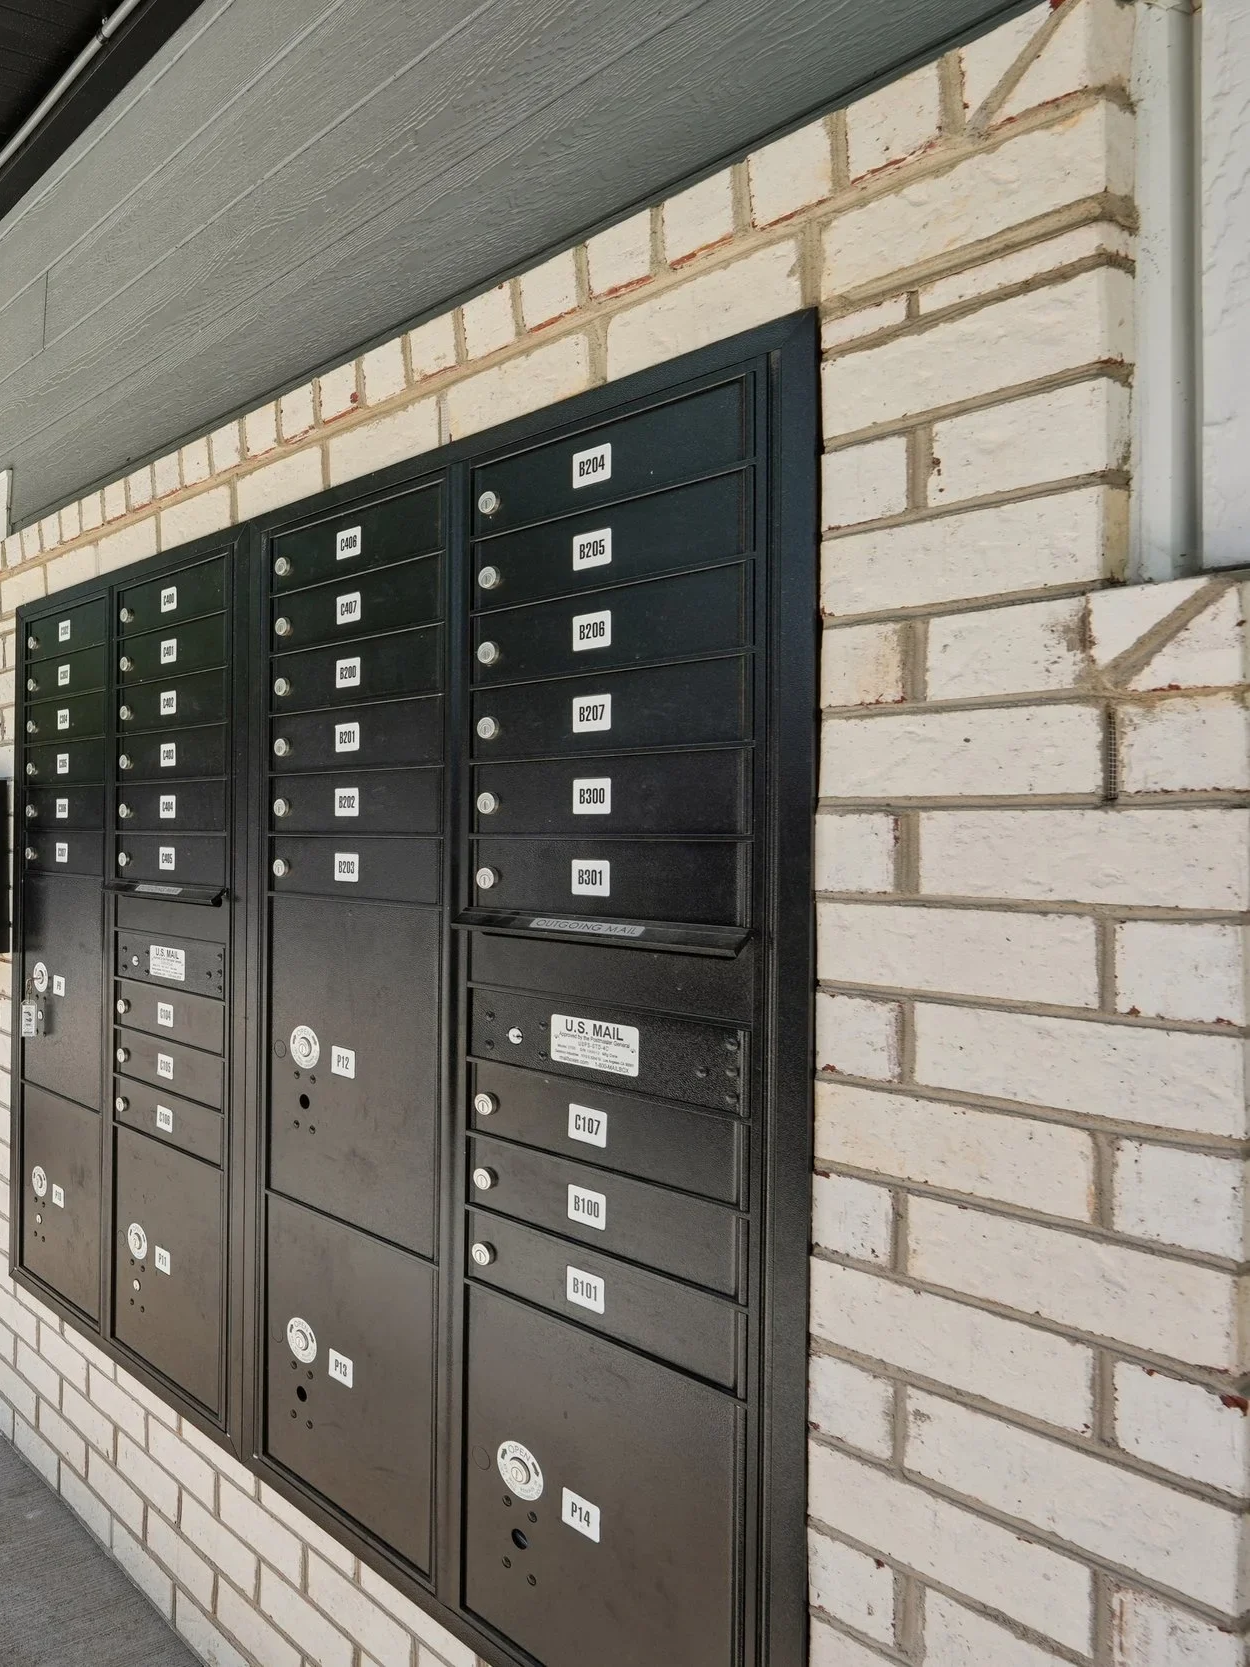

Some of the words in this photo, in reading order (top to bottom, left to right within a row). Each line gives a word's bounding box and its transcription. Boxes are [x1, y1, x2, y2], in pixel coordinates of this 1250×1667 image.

[579, 454, 605, 477] B204
[340, 535, 357, 551] C406
[579, 539, 605, 560] B205
[163, 593, 174, 606] C400
[341, 600, 357, 616] C407
[579, 620, 605, 640] B206
[163, 646, 174, 657] C401
[340, 665, 356, 680] B200
[163, 697, 174, 709] C402
[579, 704, 605, 722] B207
[339, 730, 355, 744] B201
[163, 749, 174, 760] C403
[339, 796, 355, 808] B202
[579, 788, 605, 804] B300
[162, 801, 173, 812] C404
[162, 853, 172, 864] C405
[339, 861, 355, 874] B203
[578, 869, 602, 886] B301
[536, 919, 603, 931] OUTGOING
[605, 926, 637, 934] MAIL
[166, 950, 180, 960] MAIL
[160, 1008, 171, 1021] C104
[566, 1018, 588, 1034] U.S.
[592, 1024, 624, 1041] MAIL
[160, 1060, 170, 1073] C105
[337, 1054, 349, 1070] P12
[575, 1114, 601, 1135] C107
[574, 1195, 599, 1218] B100
[573, 1277, 597, 1302] B101
[335, 1359, 347, 1377] P13
[508, 1444, 530, 1461] OPEN
[571, 1501, 590, 1527] P14
